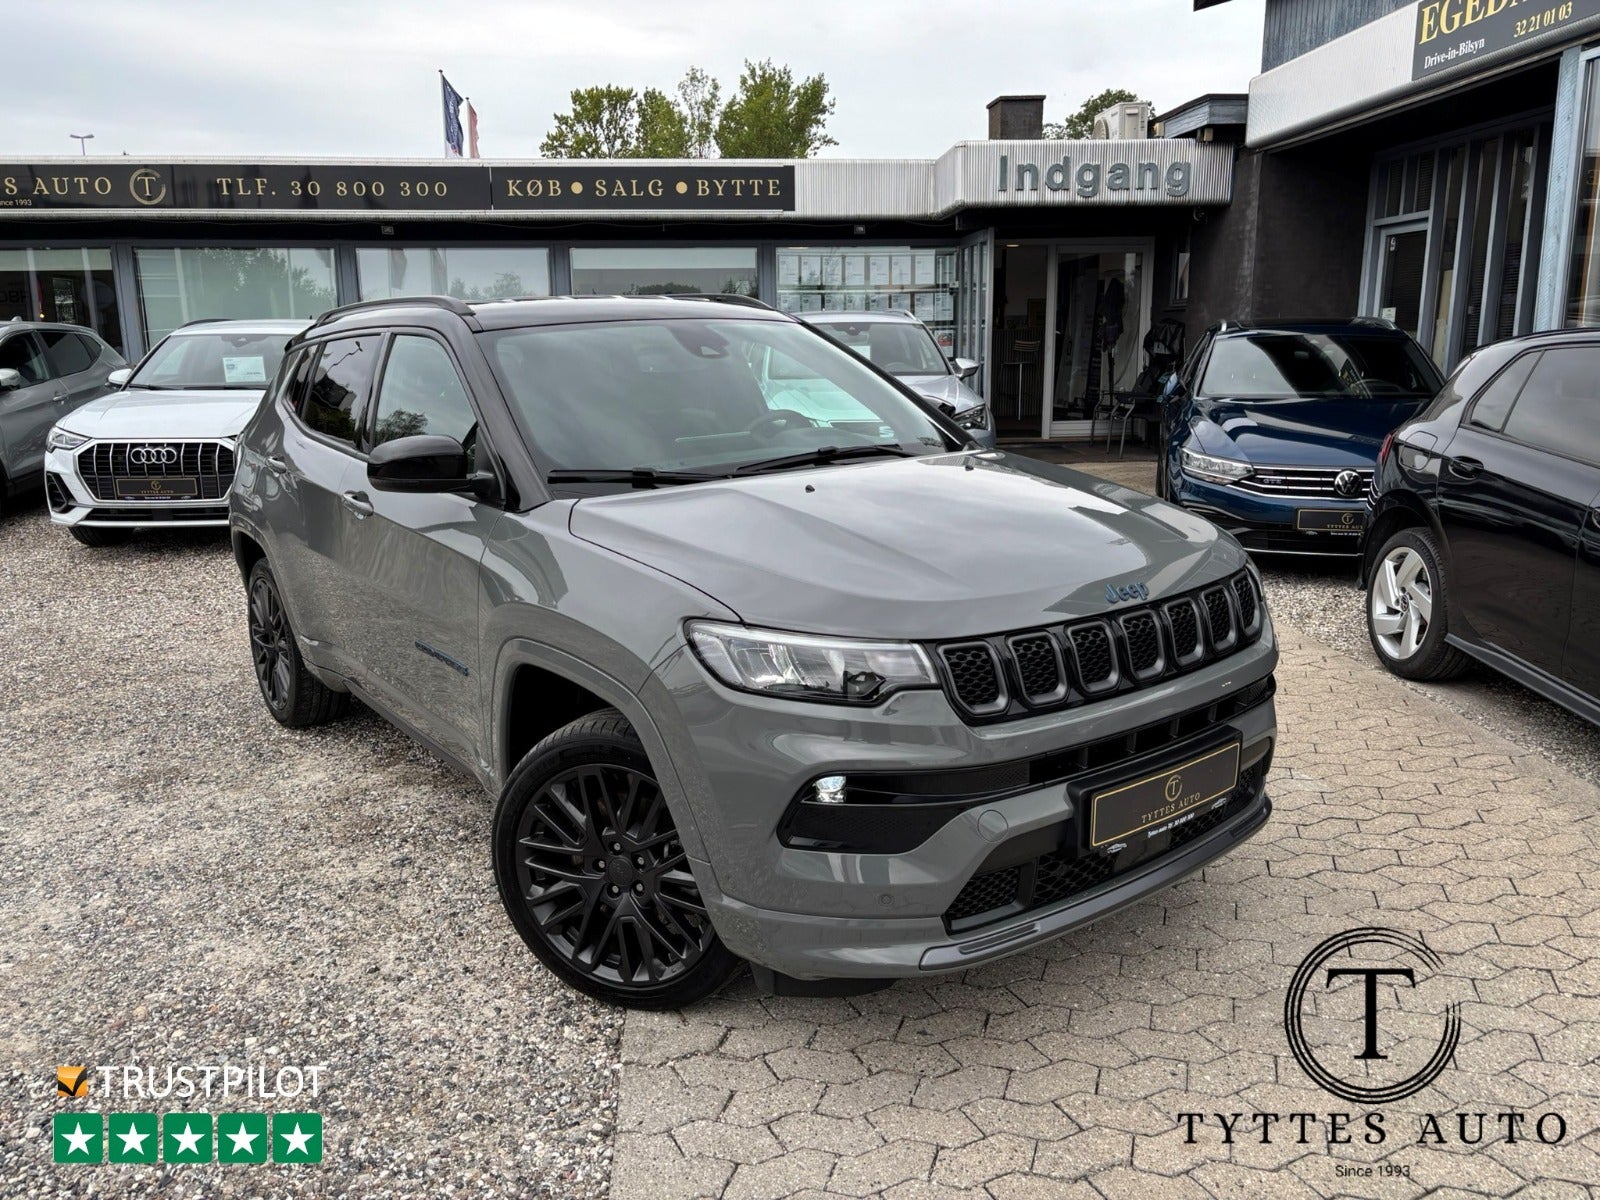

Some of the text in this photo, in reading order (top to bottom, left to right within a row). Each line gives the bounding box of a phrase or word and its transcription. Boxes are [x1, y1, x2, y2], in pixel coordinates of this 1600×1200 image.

[1514, 2, 1573, 38] 32 21 01 03
[1424, 38, 1486, 69] Drive-in-Bilsyn
[33, 177, 113, 196] AUTO
[217, 178, 448, 198] TLF. 30 800 300
[507, 179, 781, 198] KØB SALG BYTTE
[998, 155, 1191, 198] Indgang
[1105, 583, 1149, 604] Jeep
[1141, 792, 1200, 823] TYTTES AUTO
